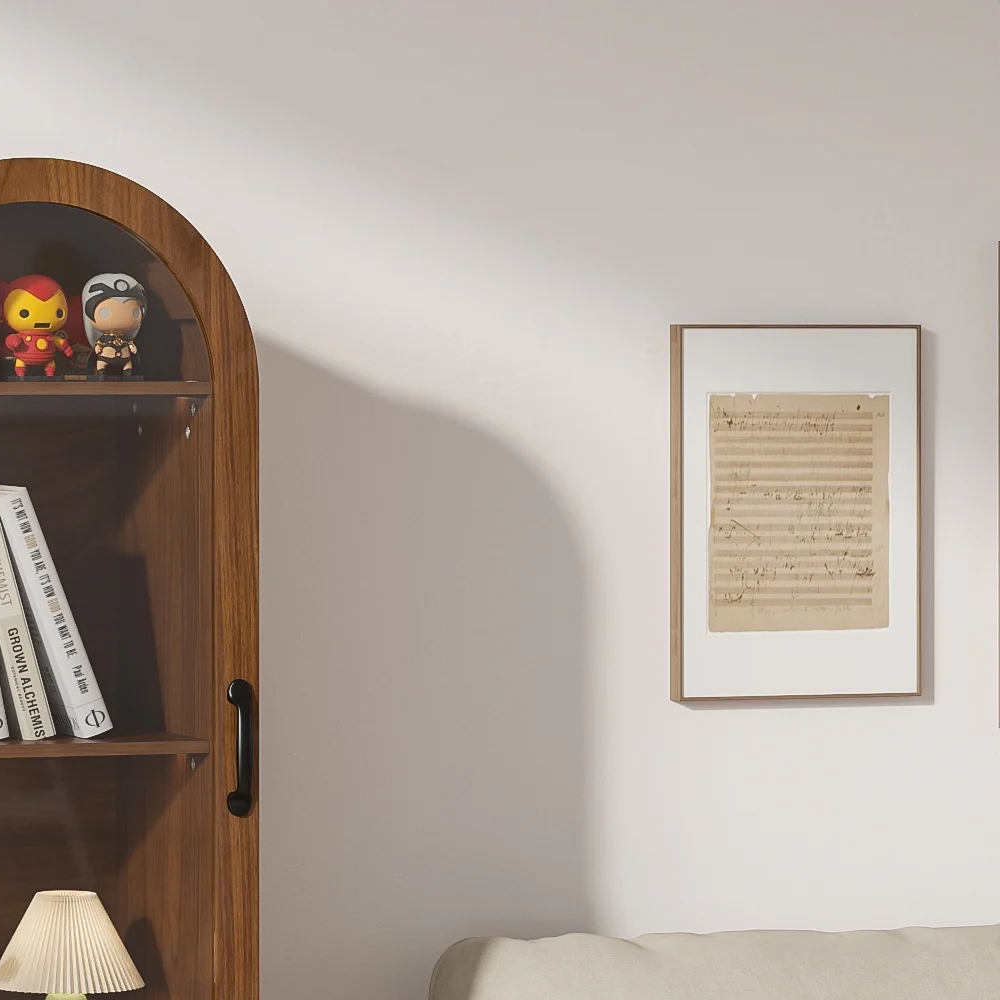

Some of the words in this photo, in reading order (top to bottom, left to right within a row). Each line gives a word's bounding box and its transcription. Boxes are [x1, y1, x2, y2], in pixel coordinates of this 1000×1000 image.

[15, 509, 27, 521] NOT
[19, 520, 33, 534] HOW
[24, 534, 38, 549] GOOD
[30, 549, 42, 560] YOU
[43, 585, 56, 598] HOW
[47, 598, 61, 613] GOOD
[53, 612, 65, 624] YOU
[58, 625, 71, 643] WANT
[63, 640, 74, 649] TO
[8, 628, 28, 673] GROWN
[21, 677, 46, 738] ALCHEMIS
[72, 665, 84, 678] Paul
[78, 678, 88, 694] Arden
